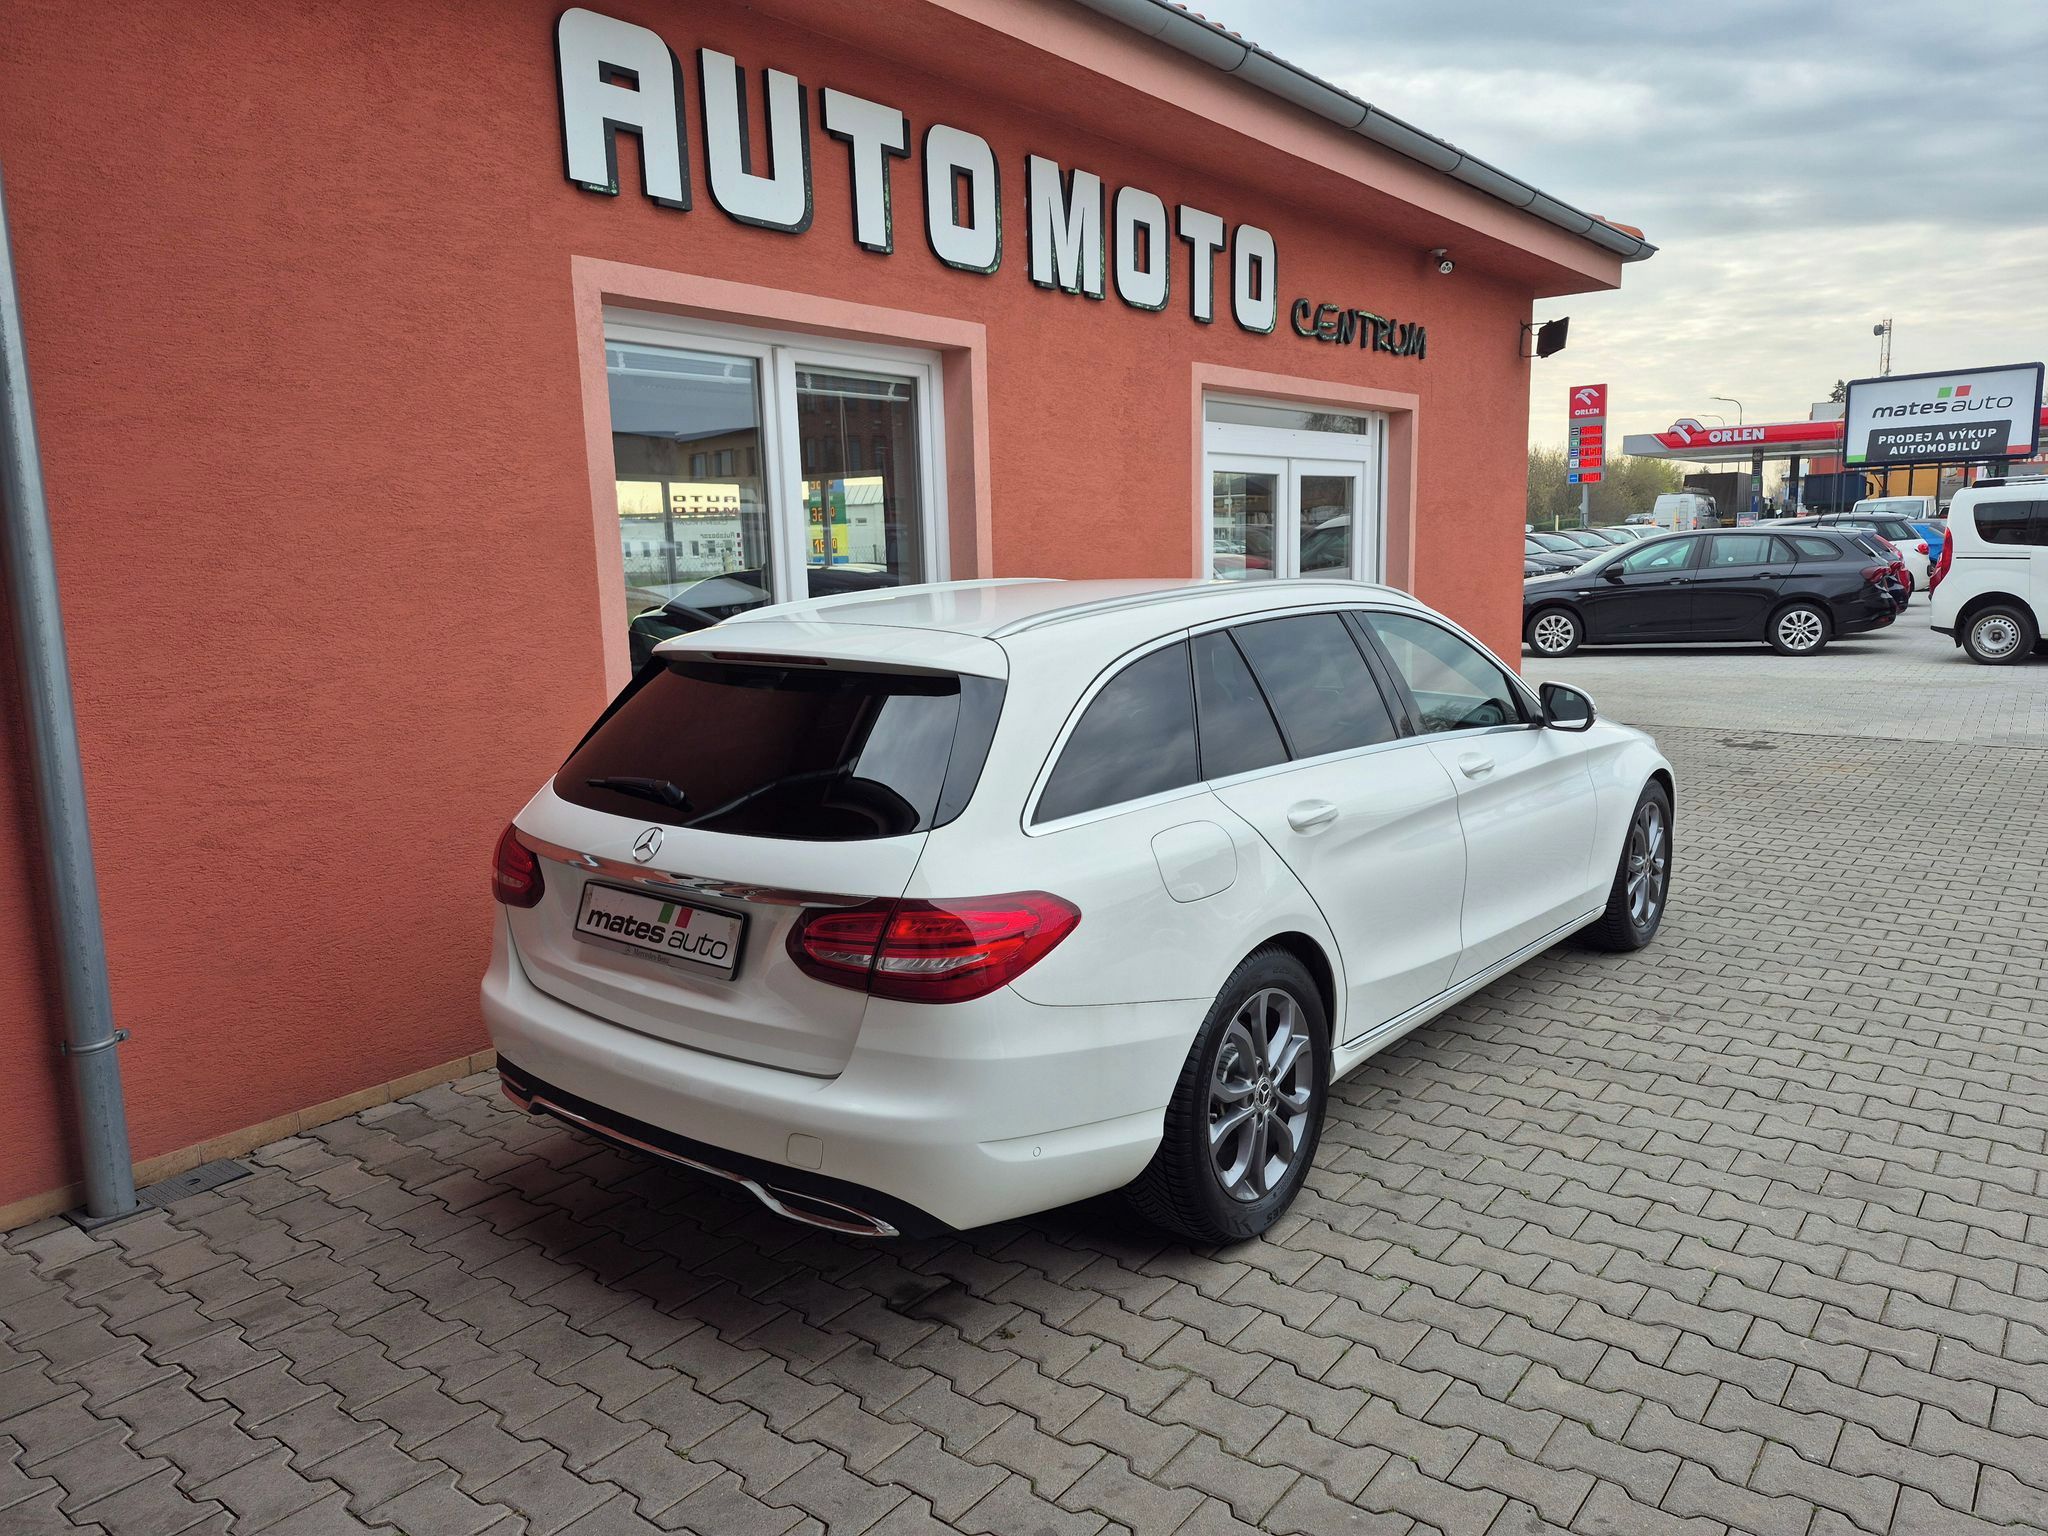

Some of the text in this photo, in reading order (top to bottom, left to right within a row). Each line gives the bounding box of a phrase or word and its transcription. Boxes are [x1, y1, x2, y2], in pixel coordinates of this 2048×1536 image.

[553, 6, 1278, 336] AUTO MOTO
[1290, 297, 1427, 360] CENTRUM
[1574, 408, 1600, 416] ORLEN
[1872, 395, 2013, 419] mates auto
[1708, 427, 1765, 443] ORLEN
[1878, 428, 1998, 445] PRODEJ A VÝKUP
[1889, 439, 1981, 455] AUTOMOBILŮ
[586, 909, 728, 960] mates auto
